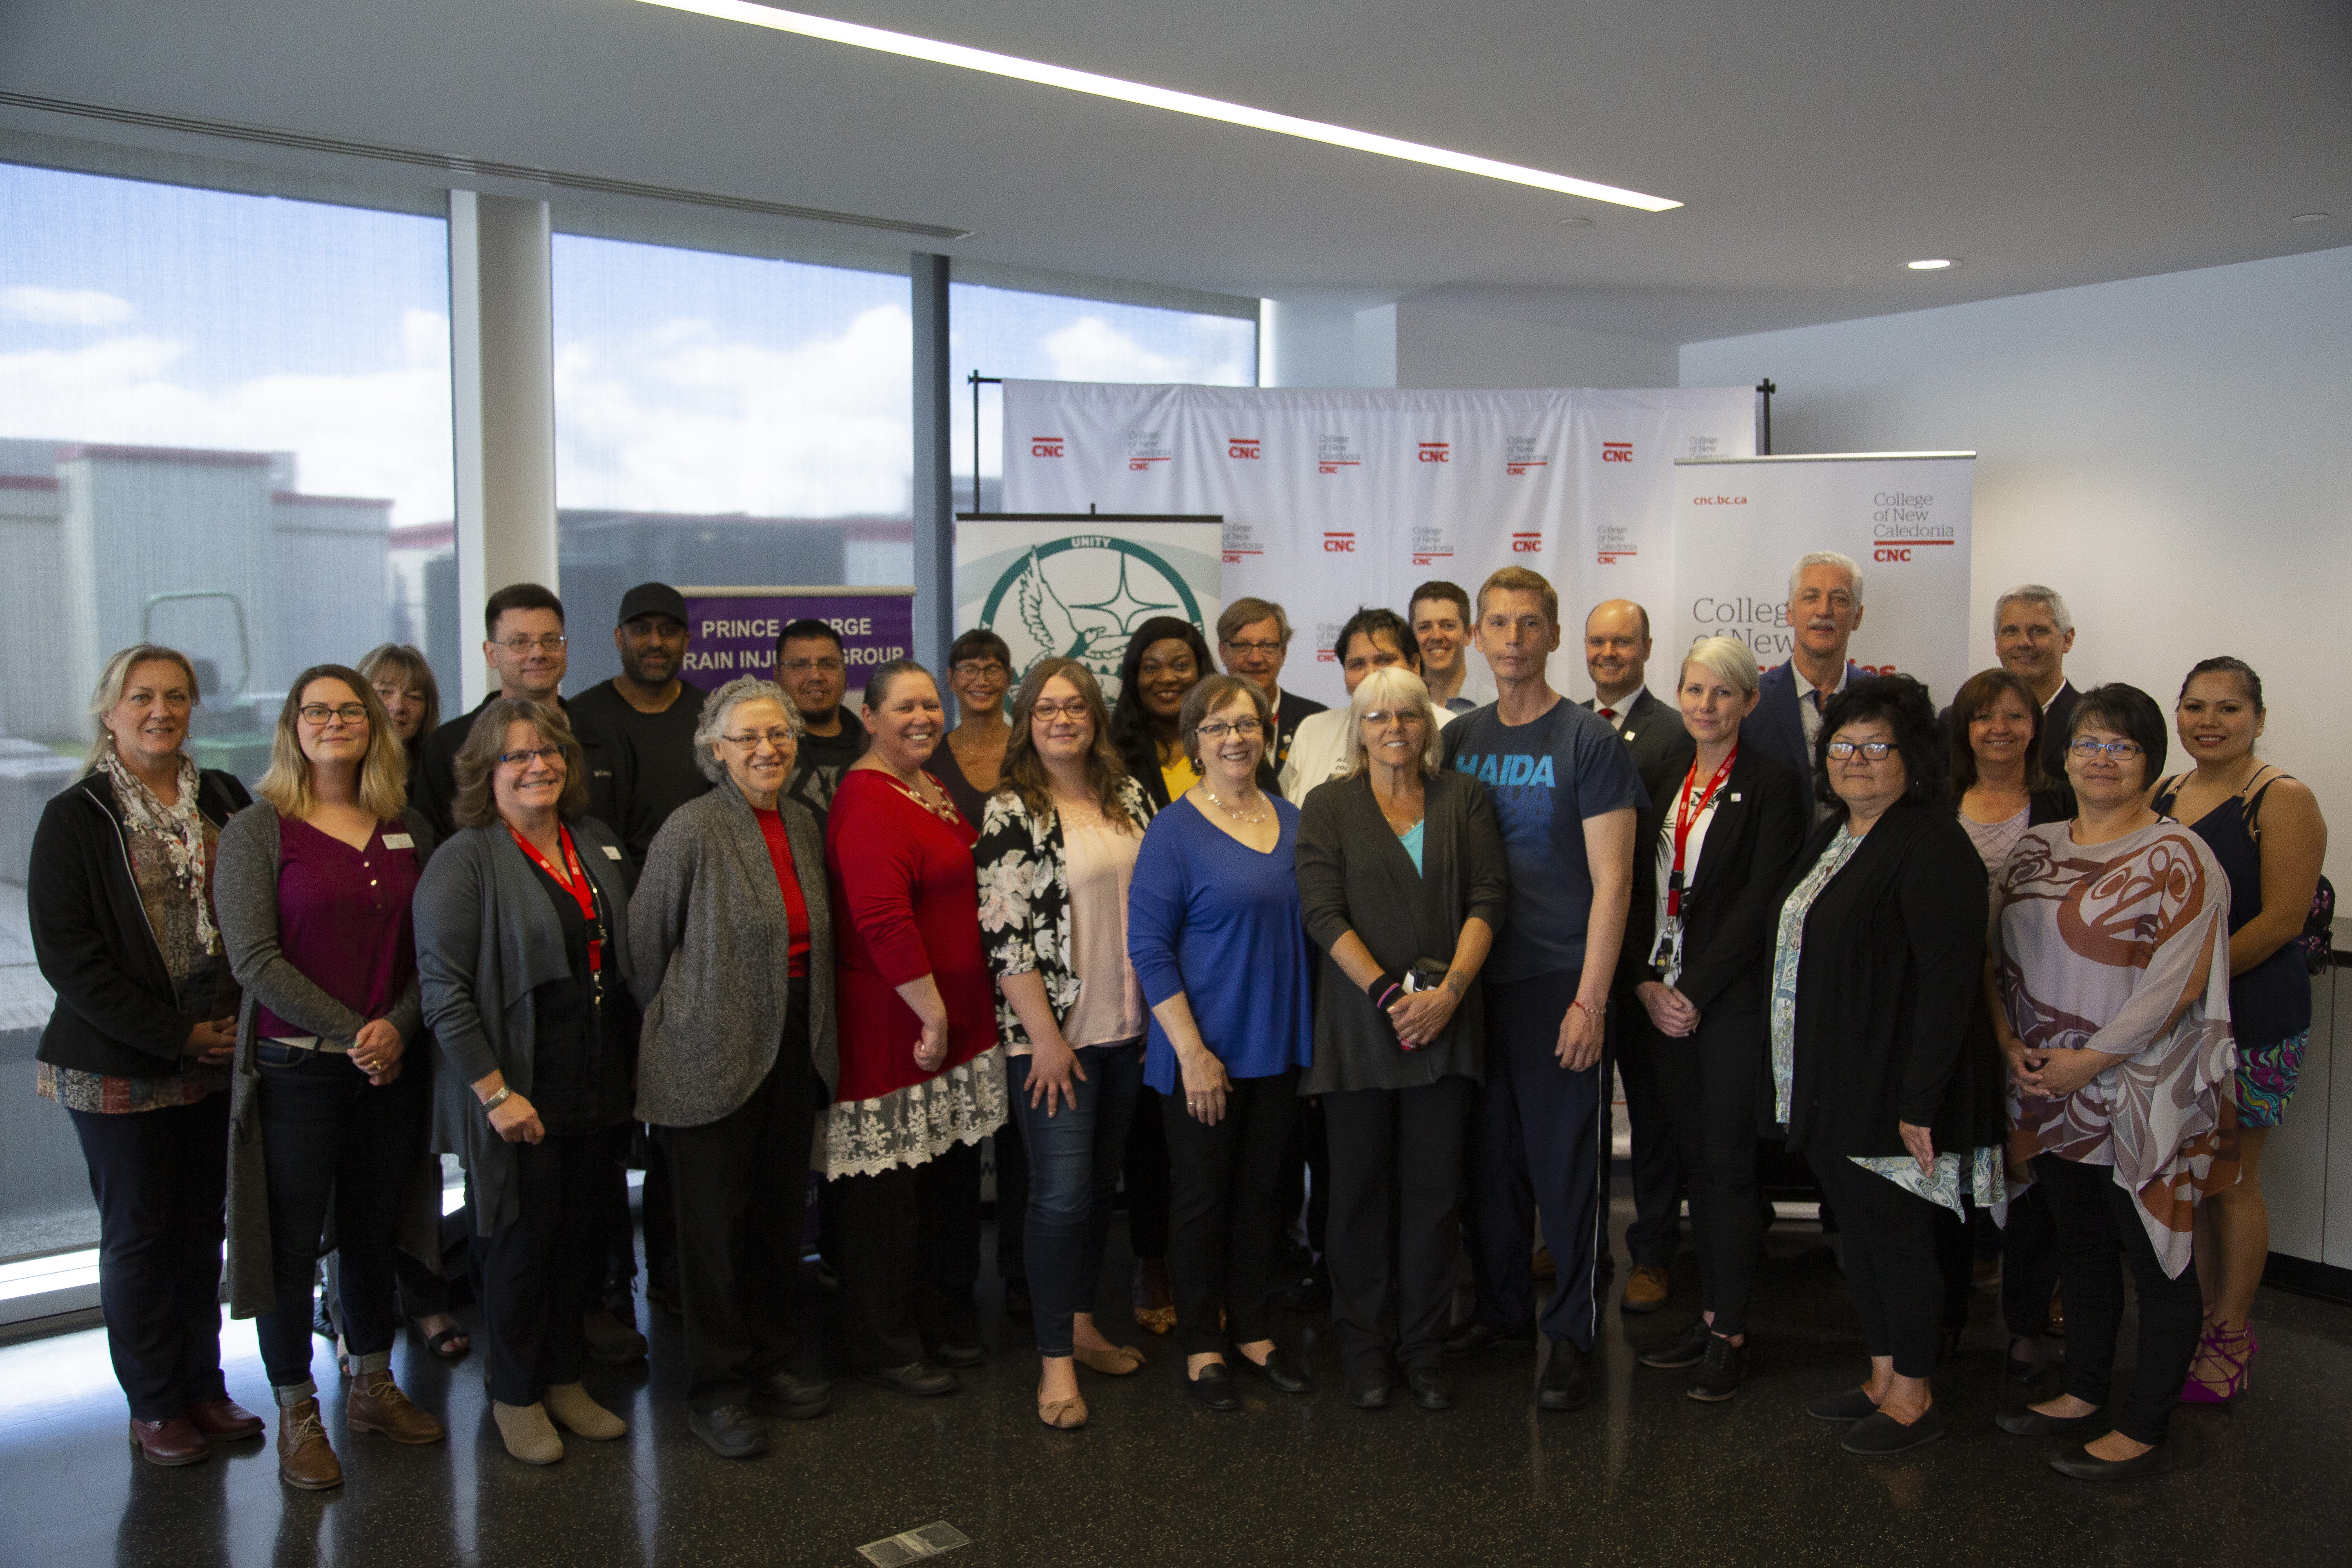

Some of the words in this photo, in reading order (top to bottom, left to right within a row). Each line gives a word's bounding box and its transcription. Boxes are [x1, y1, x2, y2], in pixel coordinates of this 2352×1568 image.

[1507, 436, 1536, 445] College
[1689, 436, 1718, 445] College
[1032, 445, 1064, 457] CNC
[1229, 446, 1260, 459] CNC
[1419, 450, 1449, 462] CNC
[1603, 450, 1633, 462] CNC
[1694, 495, 1748, 505] cnc.bc.ca
[1873, 492, 1933, 509] College
[1873, 509, 1889, 522] of
[1893, 509, 1929, 522] New
[1413, 526, 1443, 535] College
[1597, 525, 1627, 534] College
[1873, 524, 1955, 538] Caledonia
[1071, 537, 1111, 548] UNITY
[1412, 535, 1421, 543] of
[1597, 534, 1605, 542] of
[1324, 540, 1355, 552] CNC
[1512, 540, 1541, 552] CNC
[1412, 557, 1432, 566] CNC
[1873, 549, 1911, 562] CNC
[1693, 597, 1788, 628] Colleg
[702, 619, 780, 639] PRINCE
[786, 617, 873, 636] RGE
[682, 650, 734, 670] RAIN
[1456, 754, 1556, 787] HAIDA
